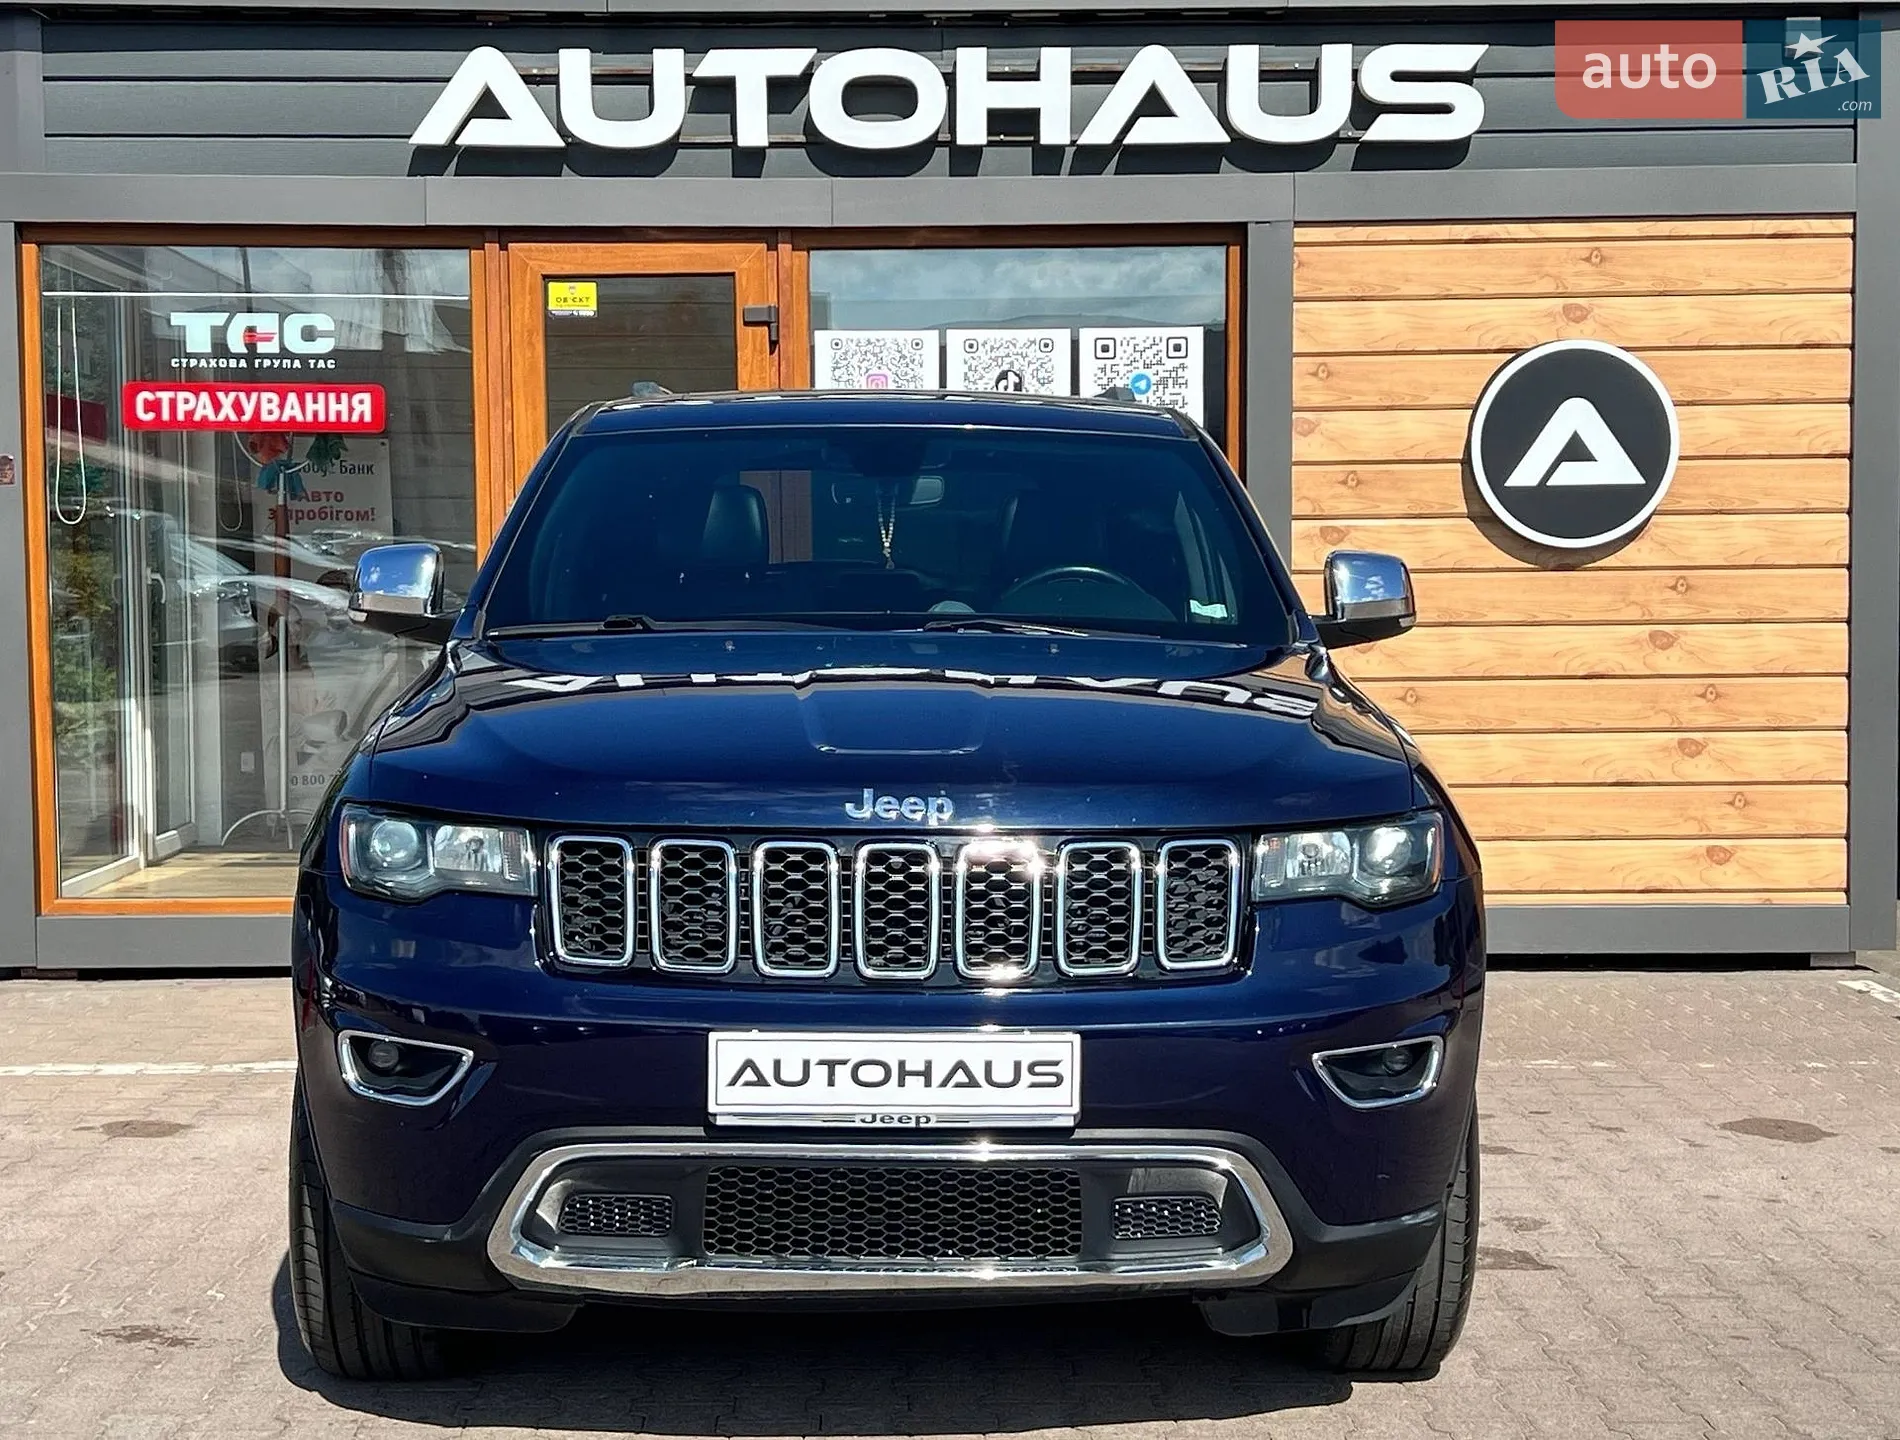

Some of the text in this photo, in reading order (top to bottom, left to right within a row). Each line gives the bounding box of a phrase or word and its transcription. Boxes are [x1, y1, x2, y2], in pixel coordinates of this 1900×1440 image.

[409, 43, 1489, 150] AUTOHAUS
[170, 358, 337, 369] СТРАХОВА ГРУПА ТАС
[135, 390, 373, 423] СТРАХУВАННЯ
[340, 460, 374, 475] Банк
[291, 775, 298, 786] 0
[302, 774, 325, 786] 800
[845, 788, 954, 826] Jeep
[726, 1058, 1065, 1089] AUTOHAUS
[859, 1113, 932, 1128] Jeep
